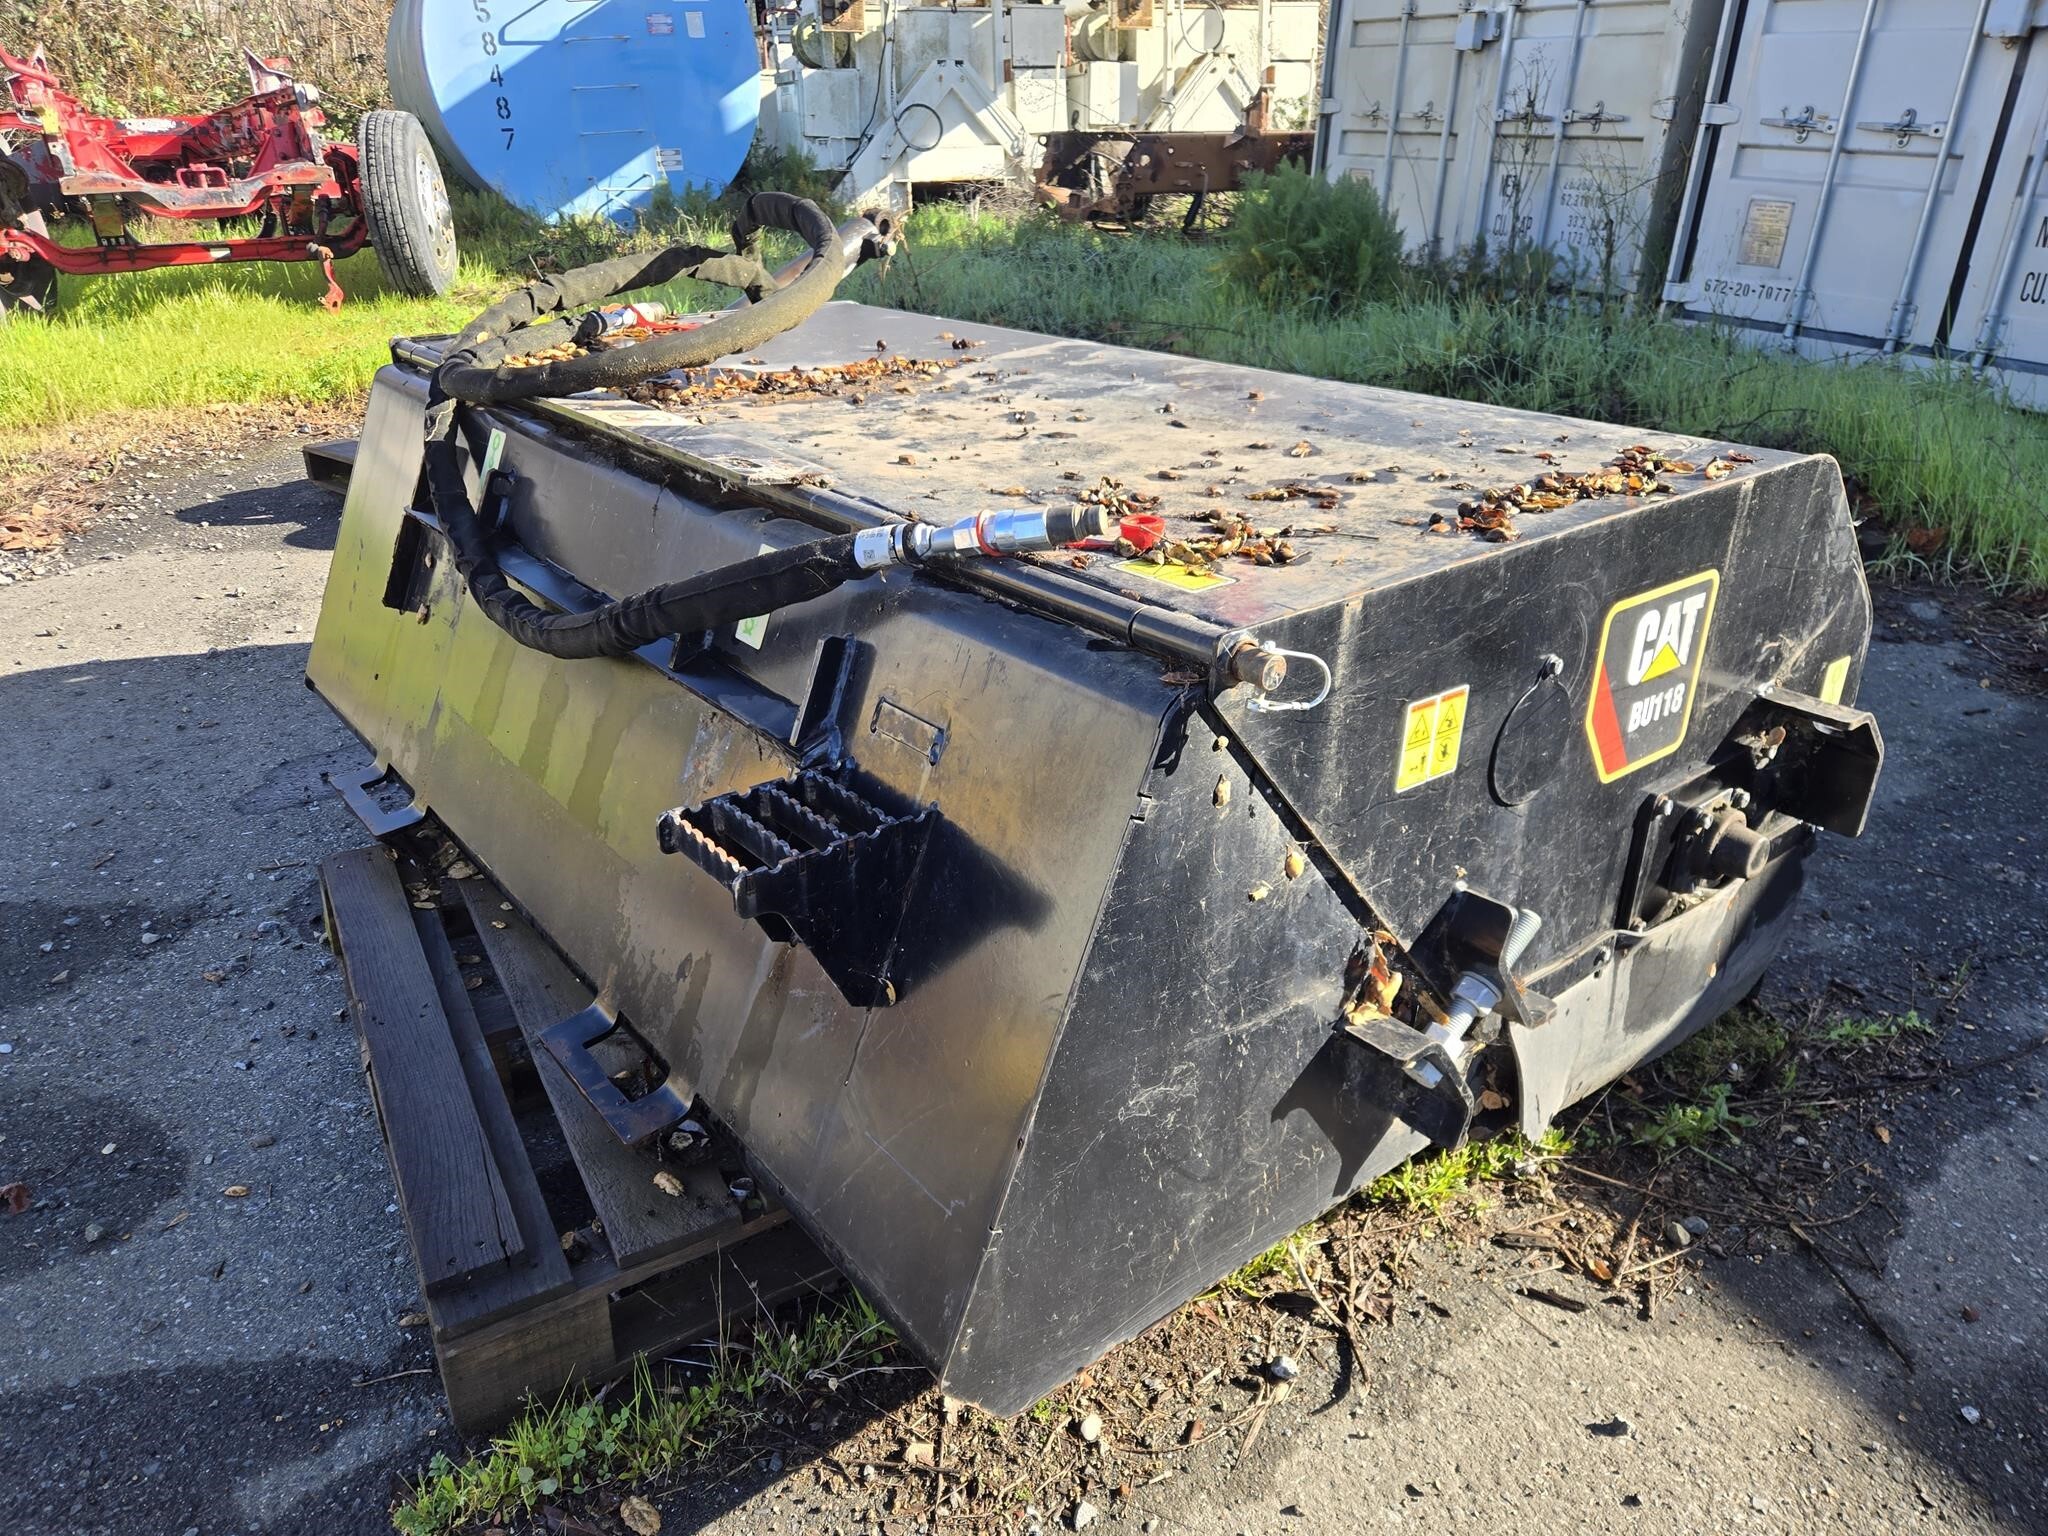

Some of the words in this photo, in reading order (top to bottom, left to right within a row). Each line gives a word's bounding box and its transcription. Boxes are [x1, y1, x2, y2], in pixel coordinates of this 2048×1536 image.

[1704, 279, 1791, 303] 672-20-7077
[1627, 592, 1707, 686] CAT
[1627, 682, 1686, 733] BU118
